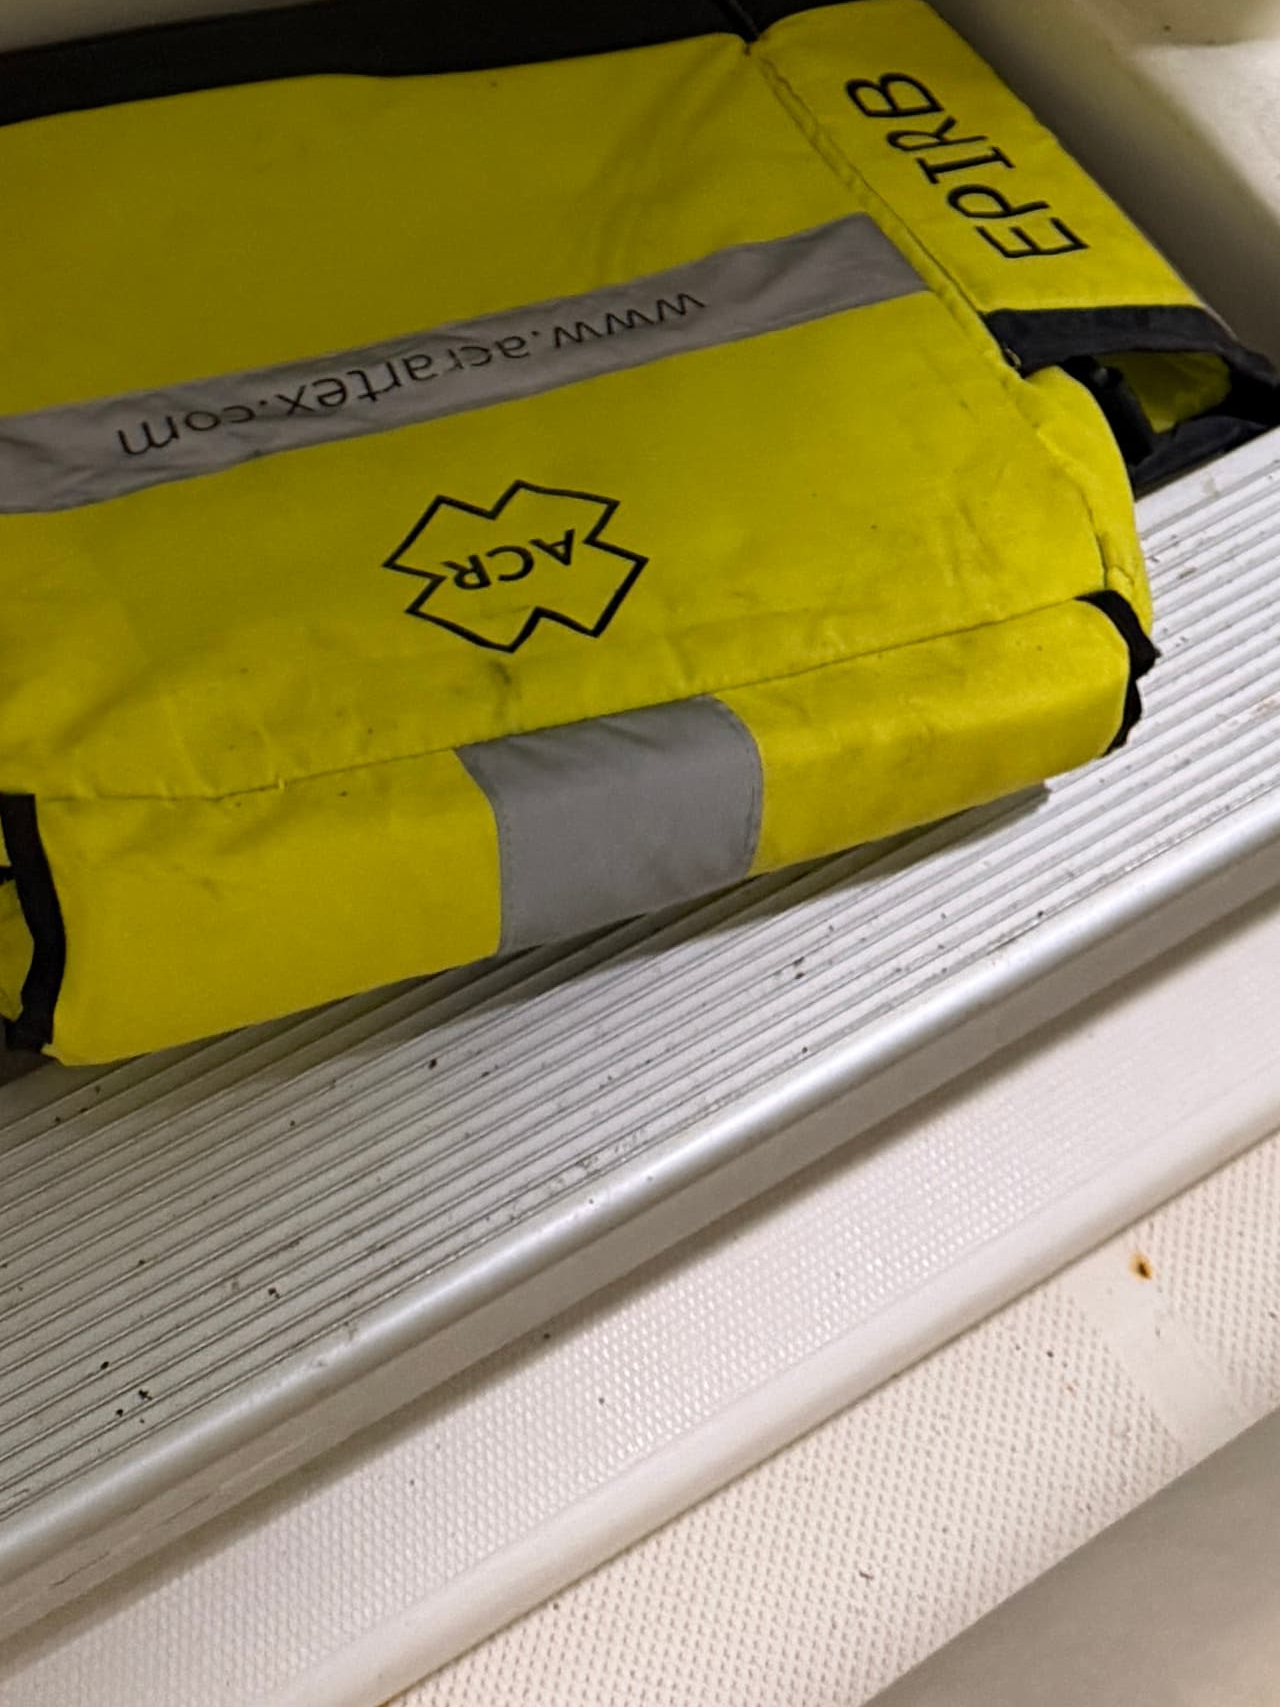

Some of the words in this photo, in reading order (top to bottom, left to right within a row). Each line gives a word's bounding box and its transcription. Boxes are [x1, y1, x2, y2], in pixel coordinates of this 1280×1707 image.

[844, 71, 1091, 259] EPIRB
[115, 291, 709, 458] www.acrartex.com
[440, 528, 576, 590] ACR
